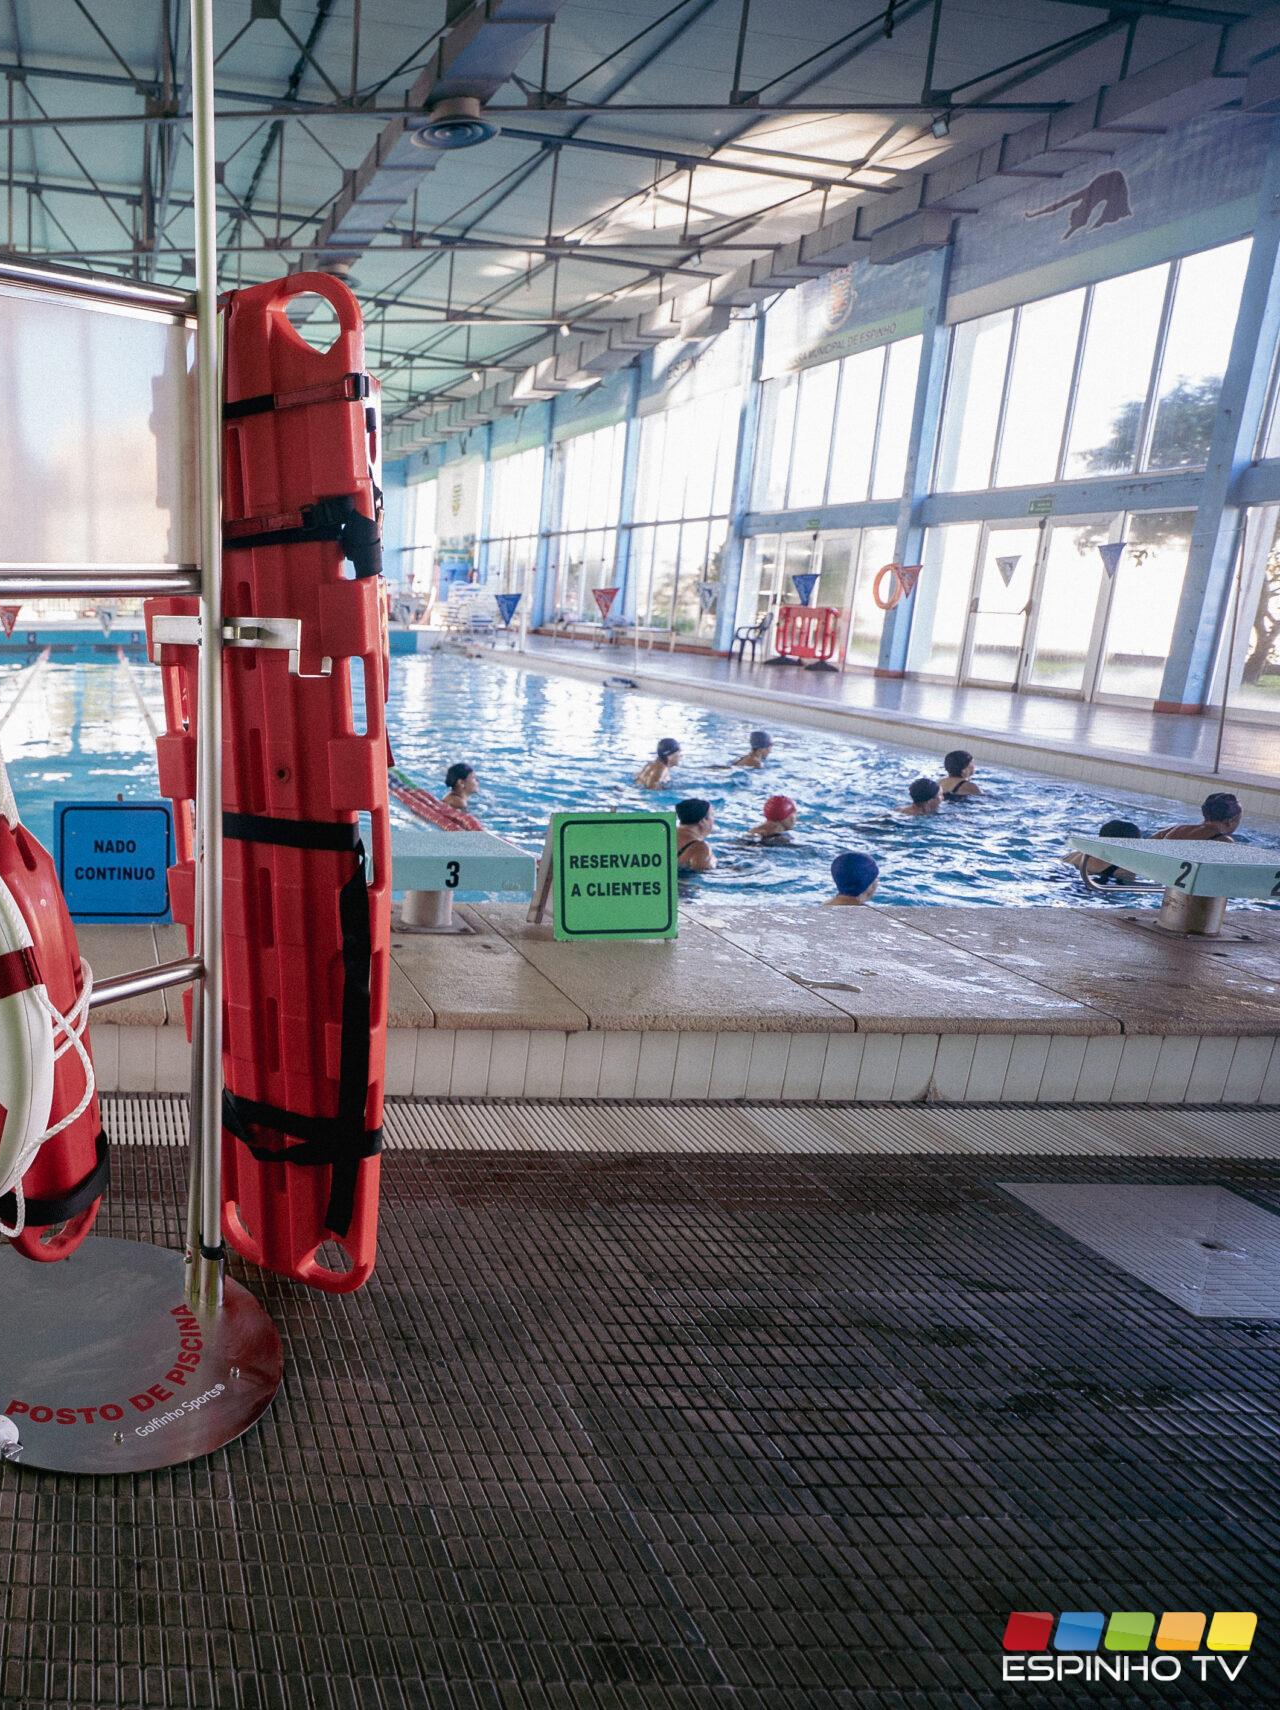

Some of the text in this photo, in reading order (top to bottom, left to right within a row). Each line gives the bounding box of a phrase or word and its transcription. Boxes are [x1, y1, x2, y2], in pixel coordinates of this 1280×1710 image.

[859, 322, 897, 342] ESPINHO
[94, 840, 136, 853] NADO
[570, 853, 662, 869] RESERVADO
[75, 867, 155, 880] CONTINUO
[445, 861, 460, 888] 3
[1174, 862, 1192, 888] 2
[571, 881, 661, 897] A CLIENTES
[4, 1303, 204, 1425] POSTO DE PISCINA
[135, 1407, 185, 1437] Golfinho
